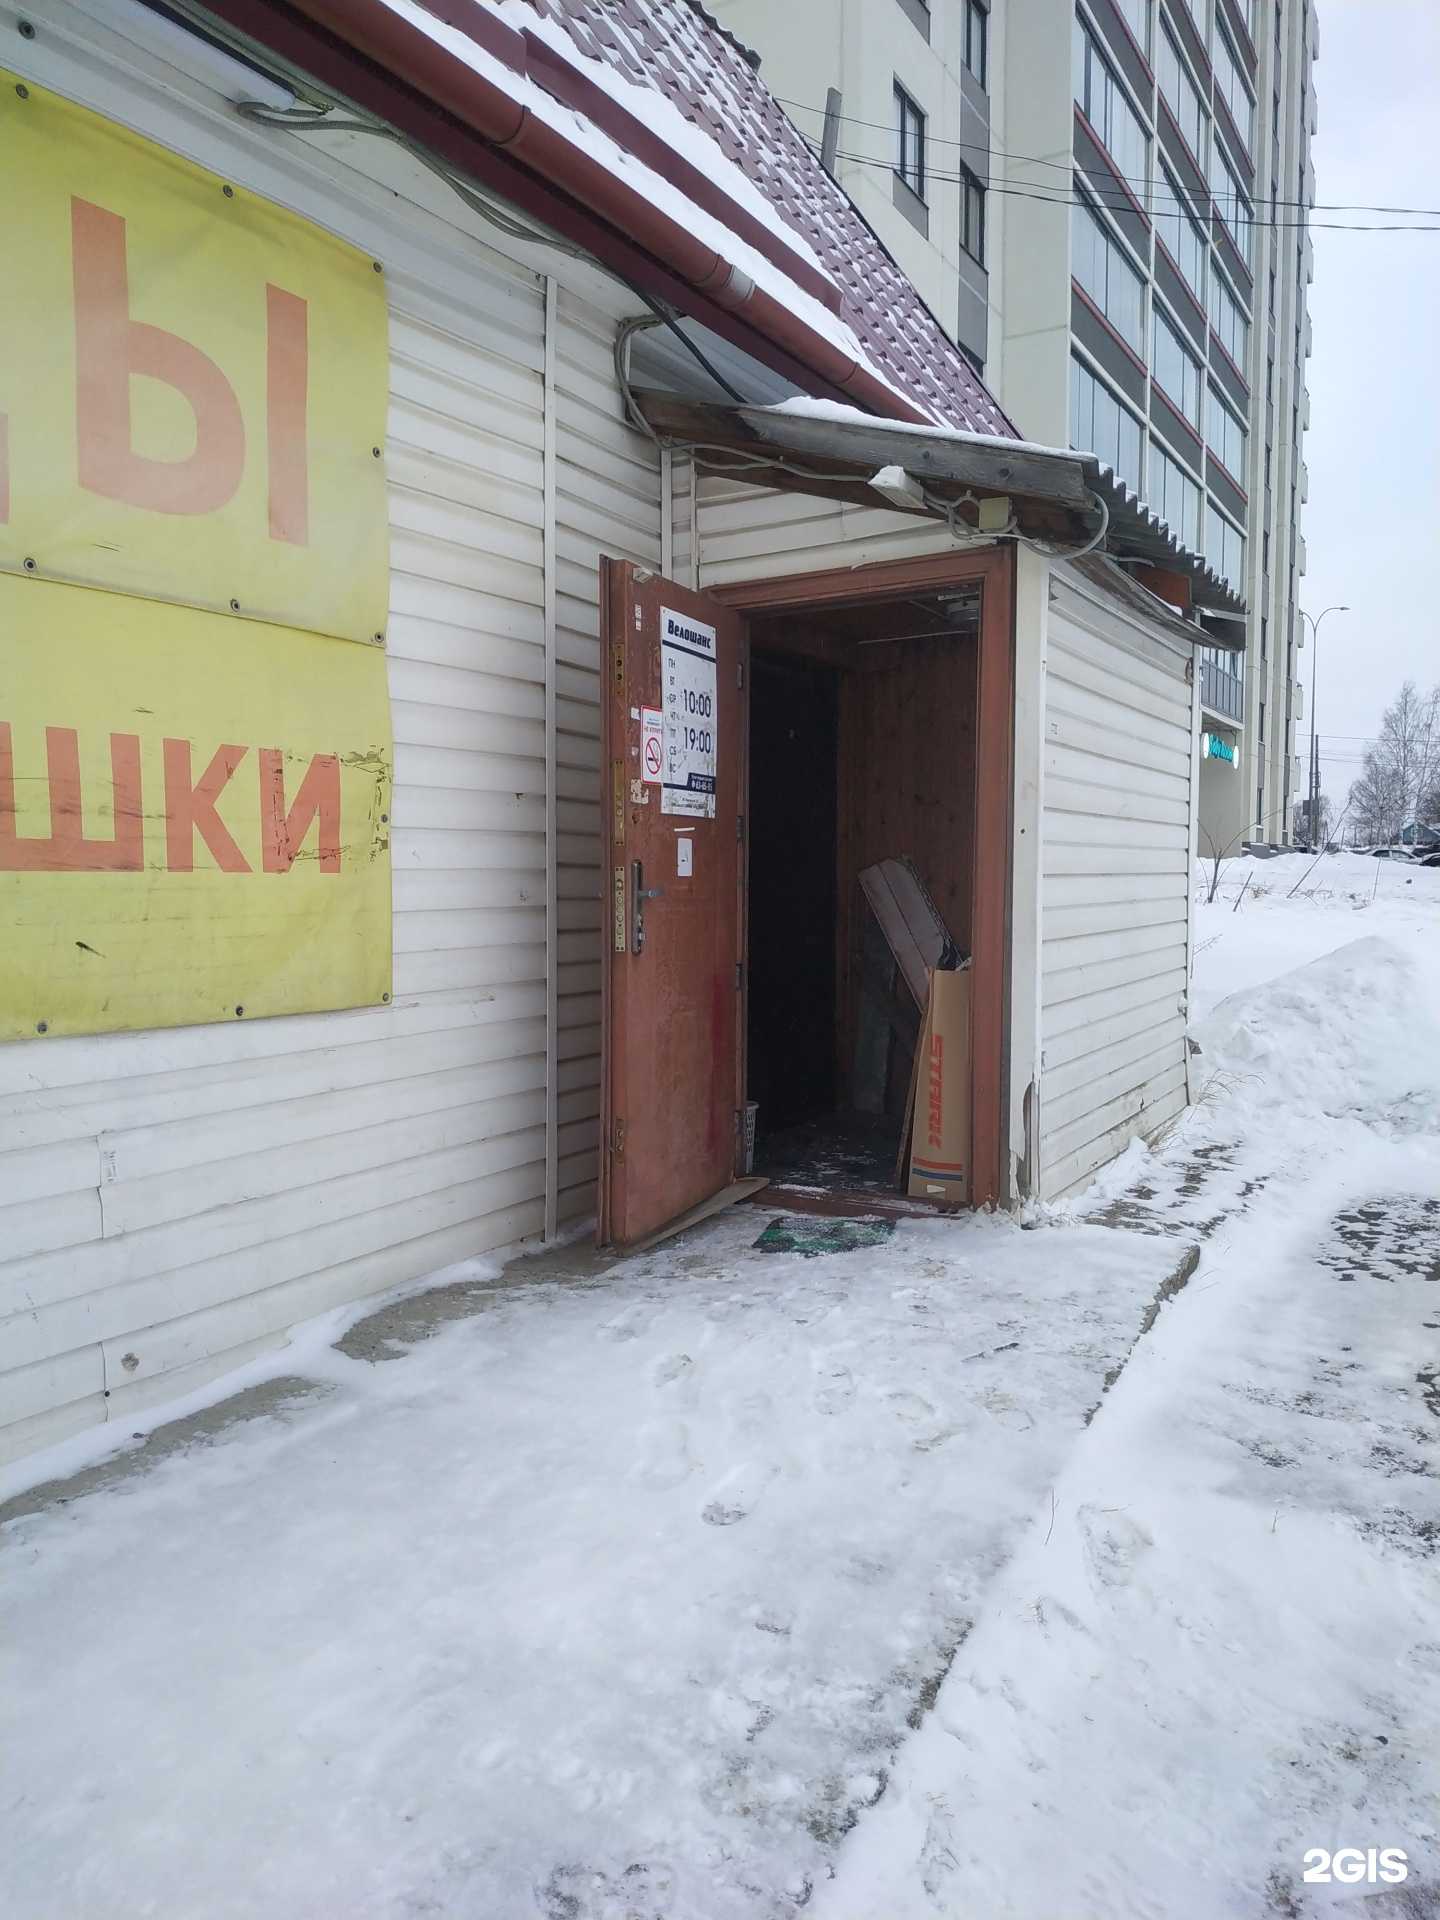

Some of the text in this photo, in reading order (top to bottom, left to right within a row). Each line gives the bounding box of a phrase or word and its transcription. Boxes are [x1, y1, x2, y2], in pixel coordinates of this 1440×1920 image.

[0, 194, 310, 548] Ы
[667, 620, 712, 649] Велошанс
[668, 658, 676, 669] ПН
[683, 688, 711, 718] 10:00
[684, 726, 711, 754] 19:00
[0, 721, 342, 874] ШКИ
